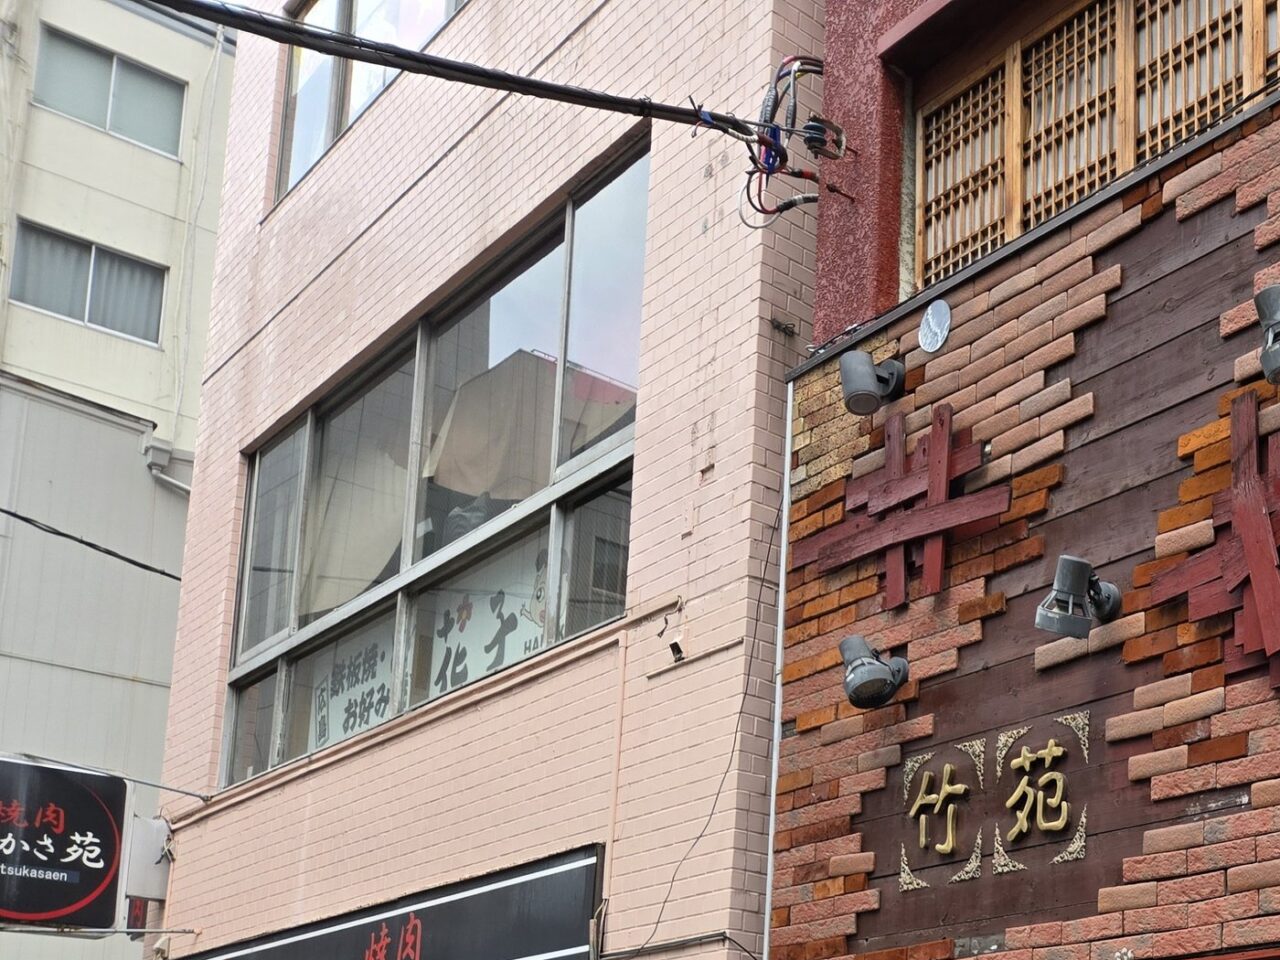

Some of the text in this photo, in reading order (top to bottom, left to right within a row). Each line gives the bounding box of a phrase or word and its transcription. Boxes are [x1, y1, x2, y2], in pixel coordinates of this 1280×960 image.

[343, 683, 390, 734] お好み
[909, 739, 1067, 854] 竹苑
[0, 864, 68, 882] tsukasaen
